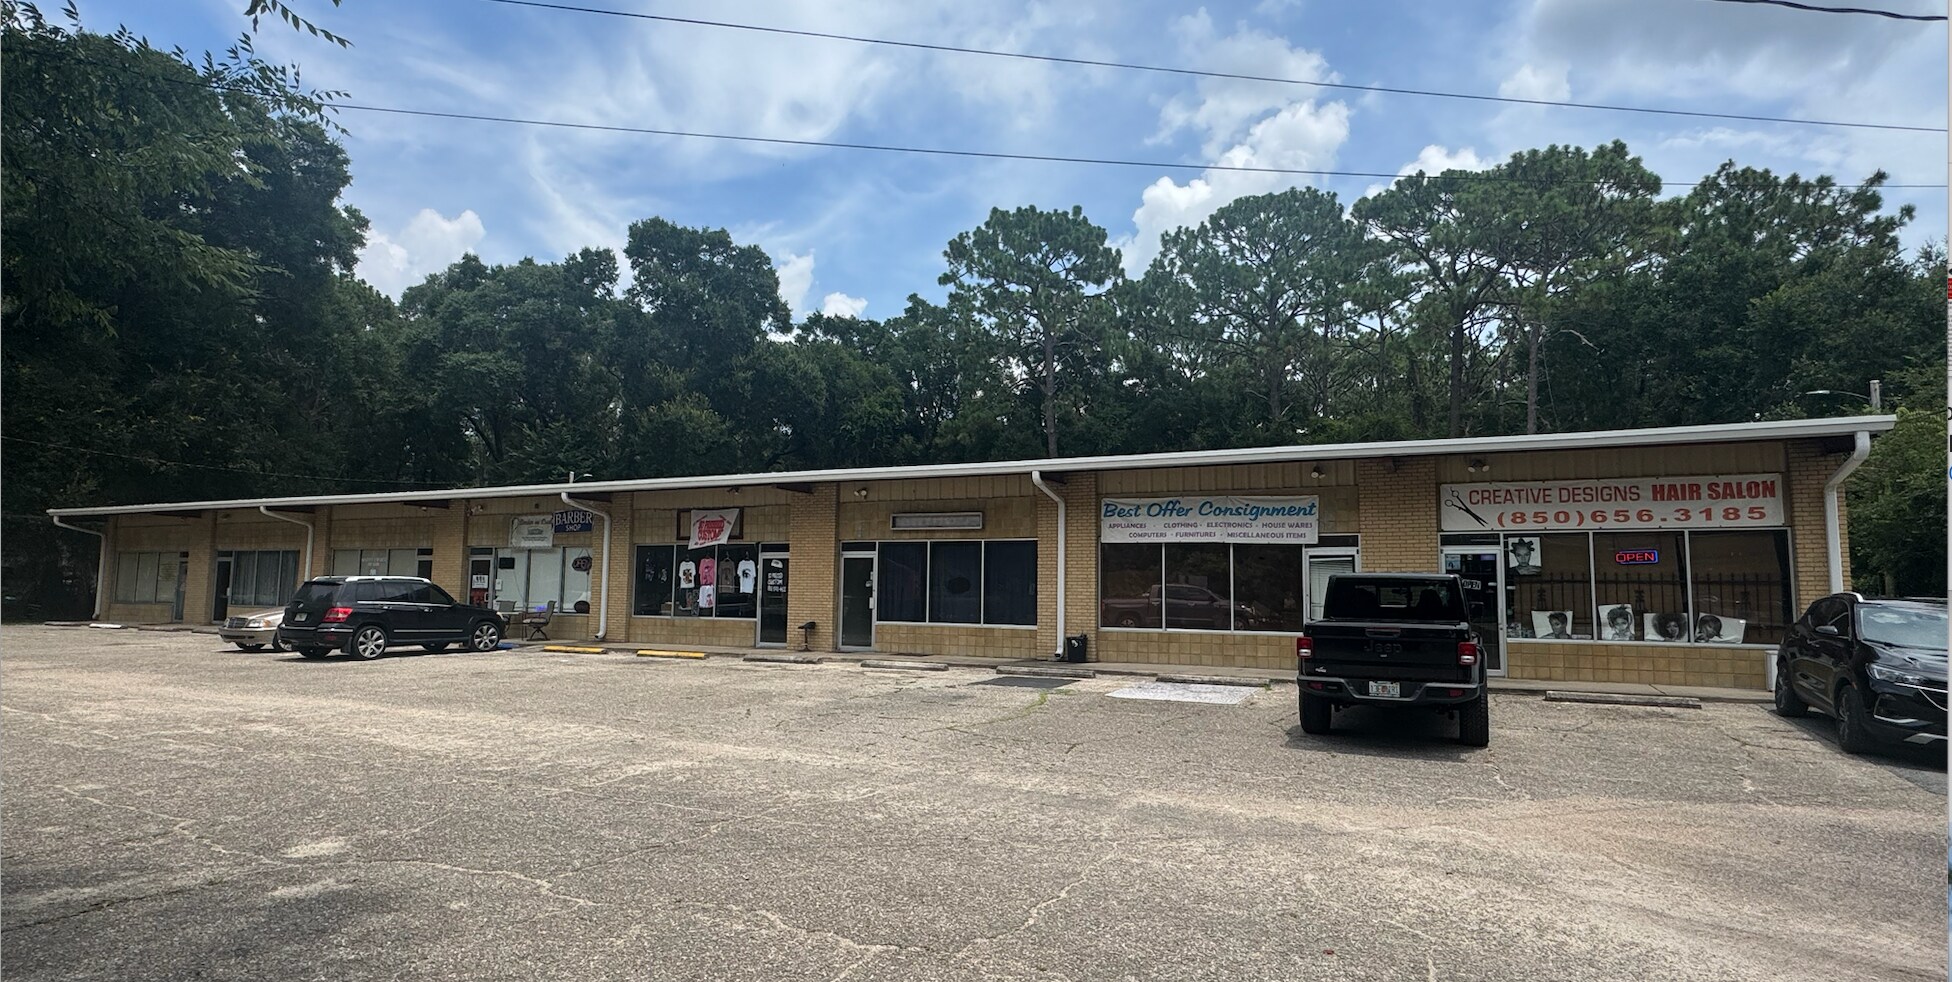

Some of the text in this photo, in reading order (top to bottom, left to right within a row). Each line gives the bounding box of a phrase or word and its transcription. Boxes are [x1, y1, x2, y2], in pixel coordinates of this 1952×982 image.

[1468, 480, 1776, 505] CREATIVE DESIGNS HAIR SALON
[1103, 500, 1317, 521] Best Offer Consignment
[1497, 506, 1767, 528] (850)656.3185
[555, 511, 593, 526] BARBER
[565, 524, 581, 532] SHOP
[1615, 551, 1655, 563] OPEN
[1363, 640, 1402, 653] Jeep
